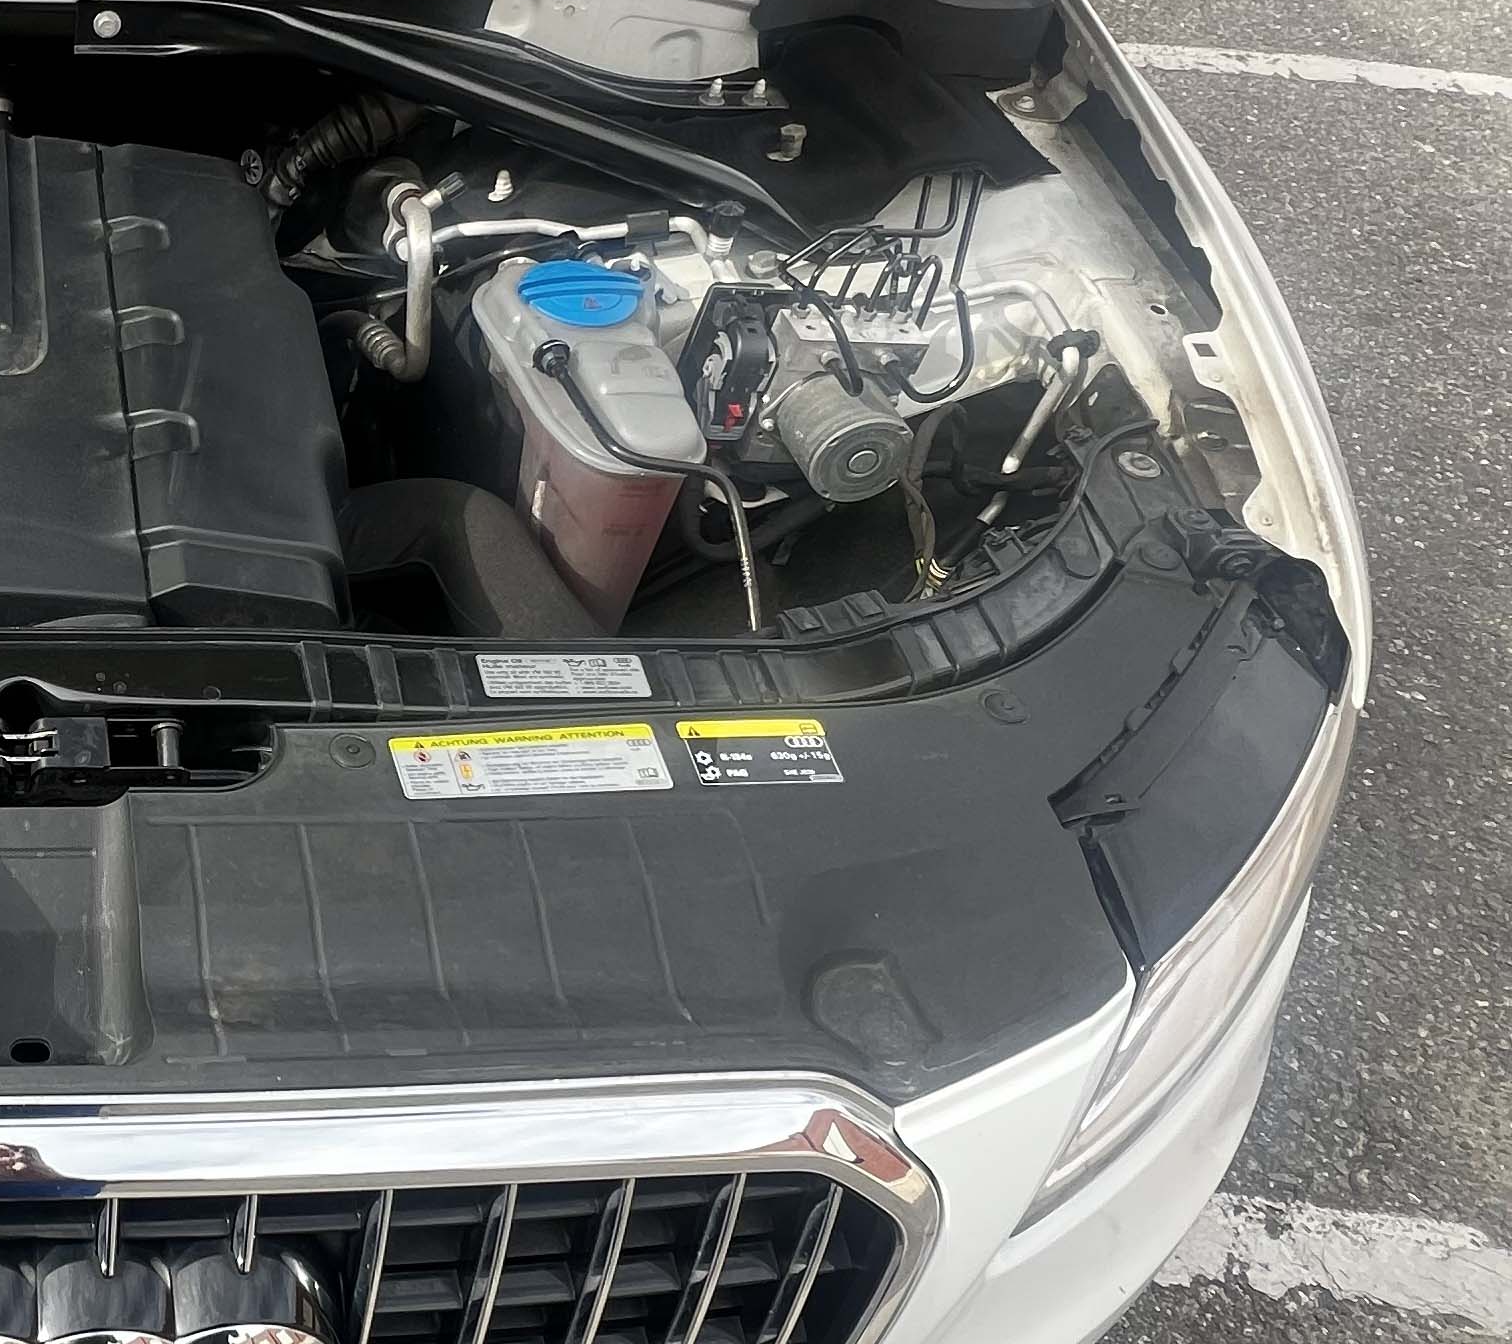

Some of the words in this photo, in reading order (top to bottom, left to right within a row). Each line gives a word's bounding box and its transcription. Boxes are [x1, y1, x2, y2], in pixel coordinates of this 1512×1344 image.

[430, 737, 488, 748] ACHTUNG
[494, 733, 552, 744] WARNING
[560, 729, 624, 740] ATTENTION
